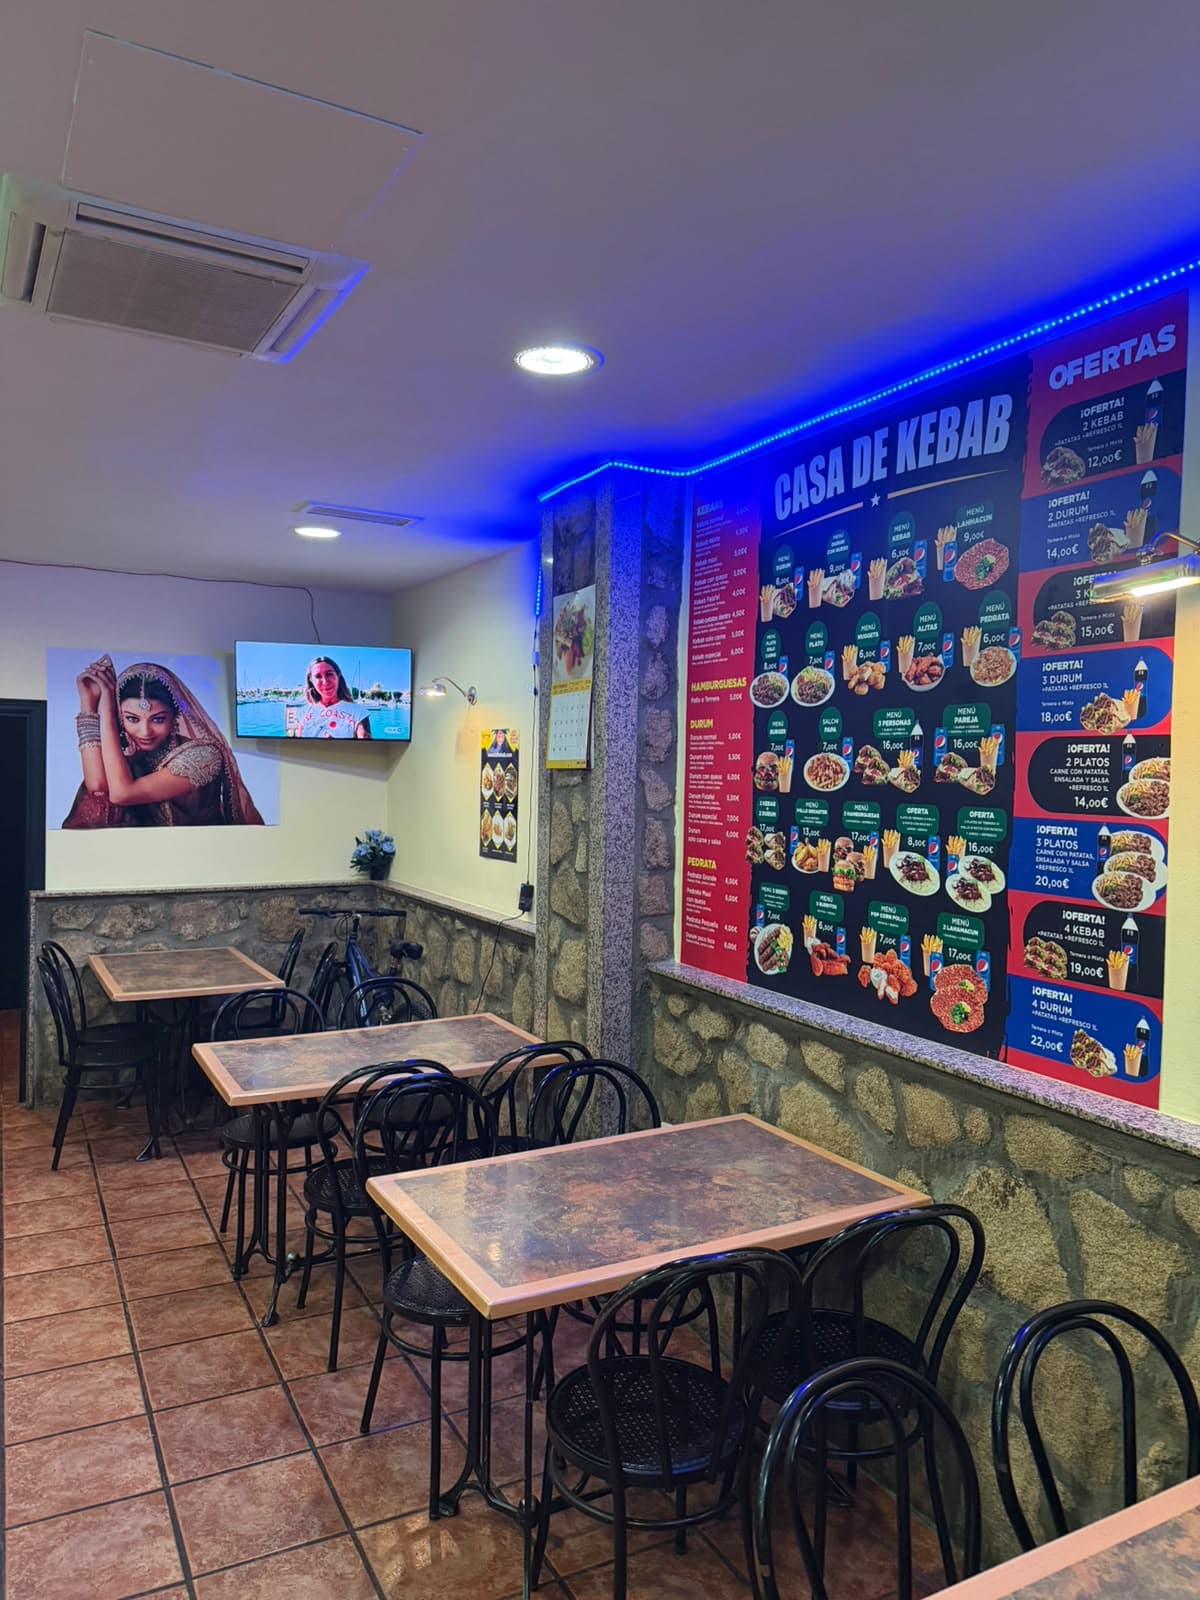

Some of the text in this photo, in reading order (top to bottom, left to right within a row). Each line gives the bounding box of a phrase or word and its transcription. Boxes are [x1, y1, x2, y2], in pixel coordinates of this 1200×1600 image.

[1049, 324, 1176, 390] OFERTAS
[1080, 397, 1125, 419] ¡OFERTA!
[1082, 411, 1124, 431] 2 KEBAB
[774, 394, 1012, 520] CASA DE KEBAB
[1088, 449, 1122, 468] 12,00€
[1048, 490, 1089, 508] ¡OFERTA!
[966, 505, 984, 516] MENÚ
[1048, 504, 1088, 521] 2 DURUM
[894, 522, 909, 532] MENÚ
[892, 532, 911, 541] KEBAB
[964, 531, 984, 542] 9,00€
[892, 548, 909, 558] 6,50€
[1046, 544, 1079, 559] 14,00€
[1076, 590, 1081, 599] 3
[986, 602, 1005, 612] MENÚ
[919, 614, 936, 623] MENÚ
[917, 623, 938, 632] ALITAS
[1081, 624, 1114, 638] 15,00€
[809, 640, 824, 648] PLATO
[983, 633, 1005, 644] 6,00€
[917, 642, 936, 652] 7,00€
[859, 649, 876, 659] 6,50€
[1042, 659, 1083, 672] ¡OFERTA!
[1042, 673, 1082, 684] 3 DURUM
[691, 677, 747, 692] HAMBURGUESAS
[957, 707, 976, 715] MENÚ
[1041, 711, 1072, 724] 18,00€
[690, 719, 713, 728] DURUM
[823, 742, 838, 751] 7,00€
[883, 740, 903, 750] 16,00€
[953, 739, 978, 749] 16,00€
[1068, 744, 1110, 754] ¡OFERTA!
[1066, 758, 1110, 767] 2 PLATOS
[1074, 796, 1108, 809] 14,00€
[969, 811, 994, 819] OFERTA
[803, 828, 820, 837] 13,00€
[1037, 825, 1078, 836] ¡OFERTA!
[851, 832, 870, 841] 17,00€
[907, 837, 925, 847] 8,50€
[968, 842, 994, 854] 16,00€
[1036, 838, 1078, 850] 3 PLATOS
[687, 856, 717, 870] PEDRATA
[1036, 856, 1065, 865] ENSALADA
[1071, 859, 1089, 867] SALSA
[1035, 865, 1067, 873] +REFRESCO
[1035, 875, 1069, 889] 20,00€
[952, 918, 969, 926] MENÚ
[1062, 910, 1105, 925] ¡OFERTA!
[1064, 924, 1104, 939] 4 KEBAB
[880, 934, 896, 945] 7,00€
[948, 948, 971, 961] 17,00€
[1070, 962, 1104, 978] 19,00€
[1032, 986, 1072, 1003] ¡OFERTA!
[1032, 1000, 1072, 1016] 4 DURUM
[1030, 1035, 1063, 1053] 22,00€
